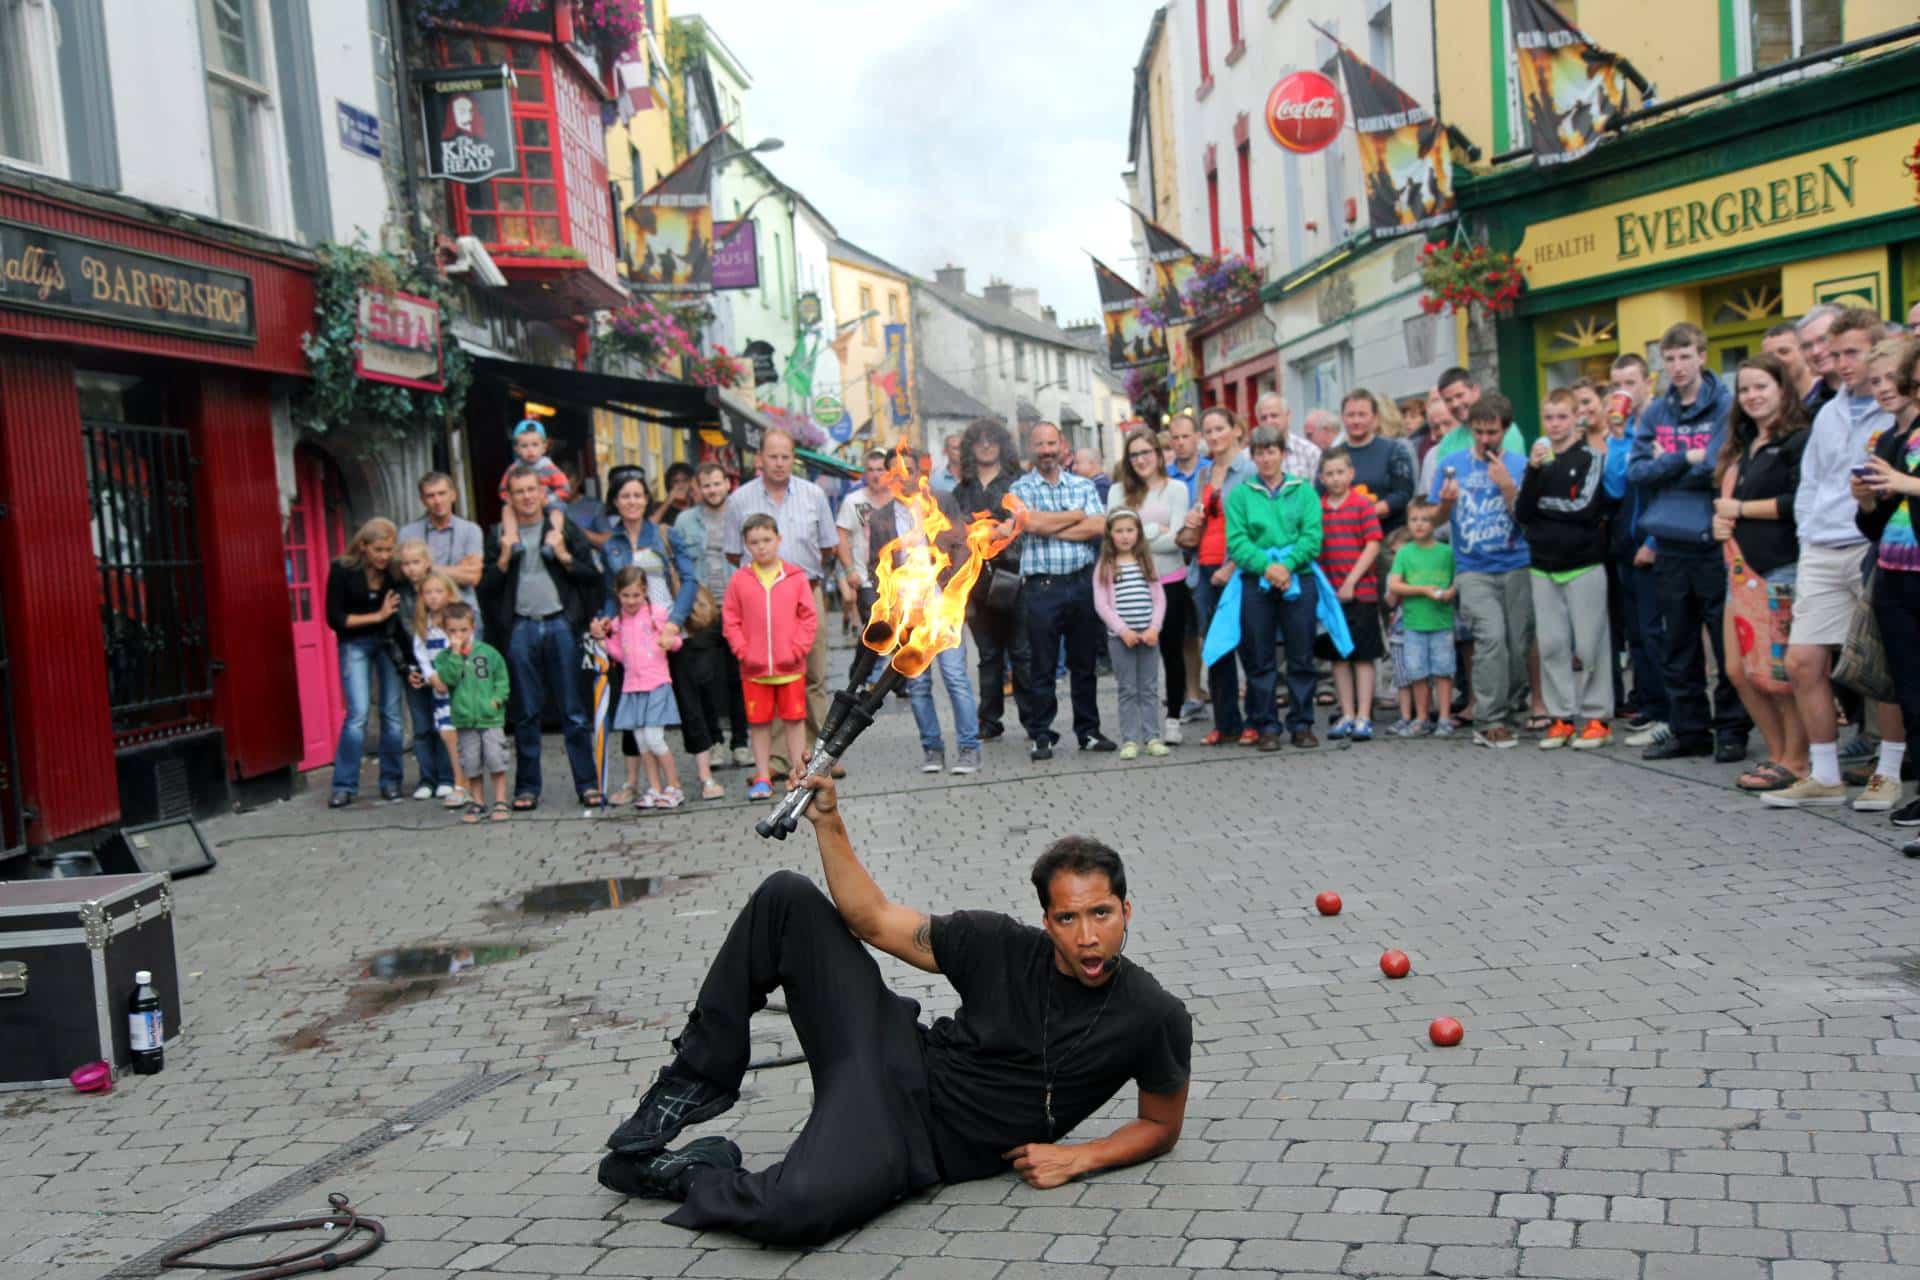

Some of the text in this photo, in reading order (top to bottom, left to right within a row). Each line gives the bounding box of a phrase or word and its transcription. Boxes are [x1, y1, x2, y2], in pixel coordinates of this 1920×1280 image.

[443, 157, 493, 173] HEAD
[1534, 233, 1596, 264] HEALTH
[1615, 155, 1858, 261] EVERGREEN
[80, 255, 247, 324] BARBERSHOP
